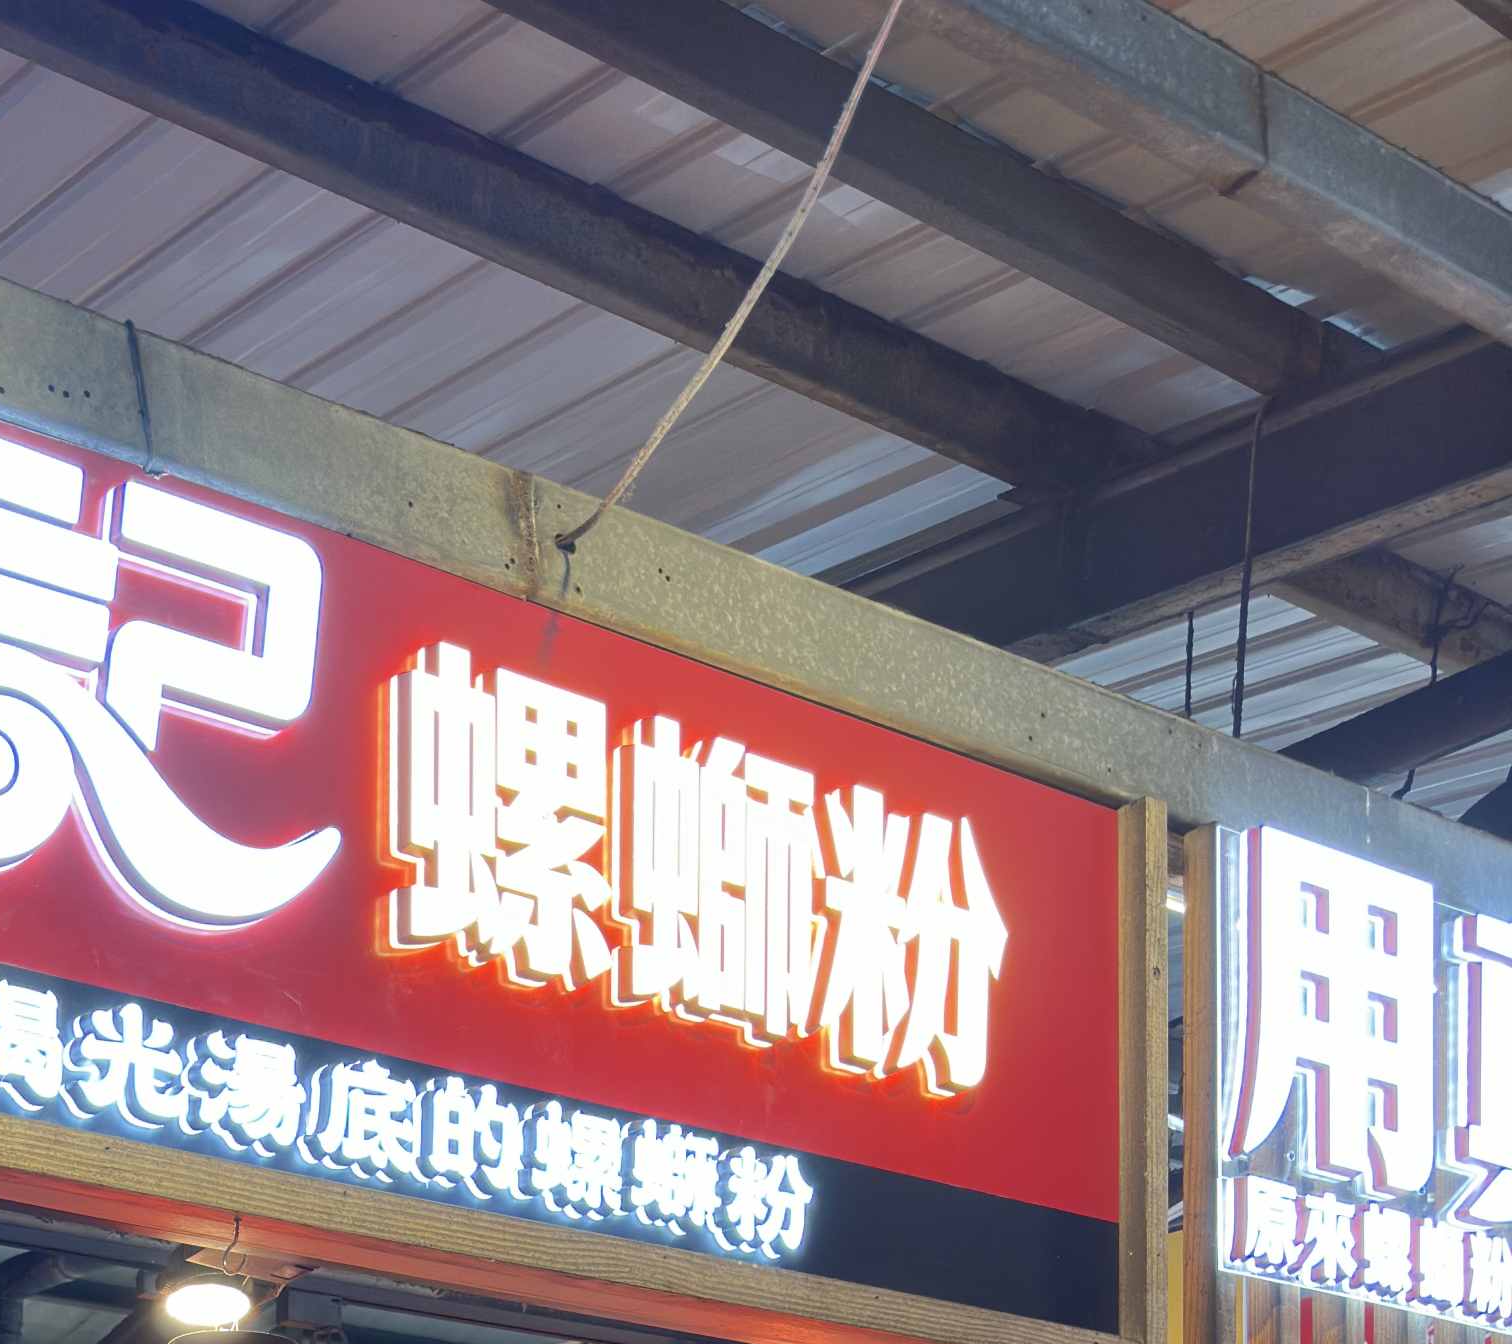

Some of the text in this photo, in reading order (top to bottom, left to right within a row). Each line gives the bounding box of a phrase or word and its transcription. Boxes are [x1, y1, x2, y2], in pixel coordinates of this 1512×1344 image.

[382, 641, 1008, 1099] 螺螄粉
[1228, 825, 1512, 1226] 用
